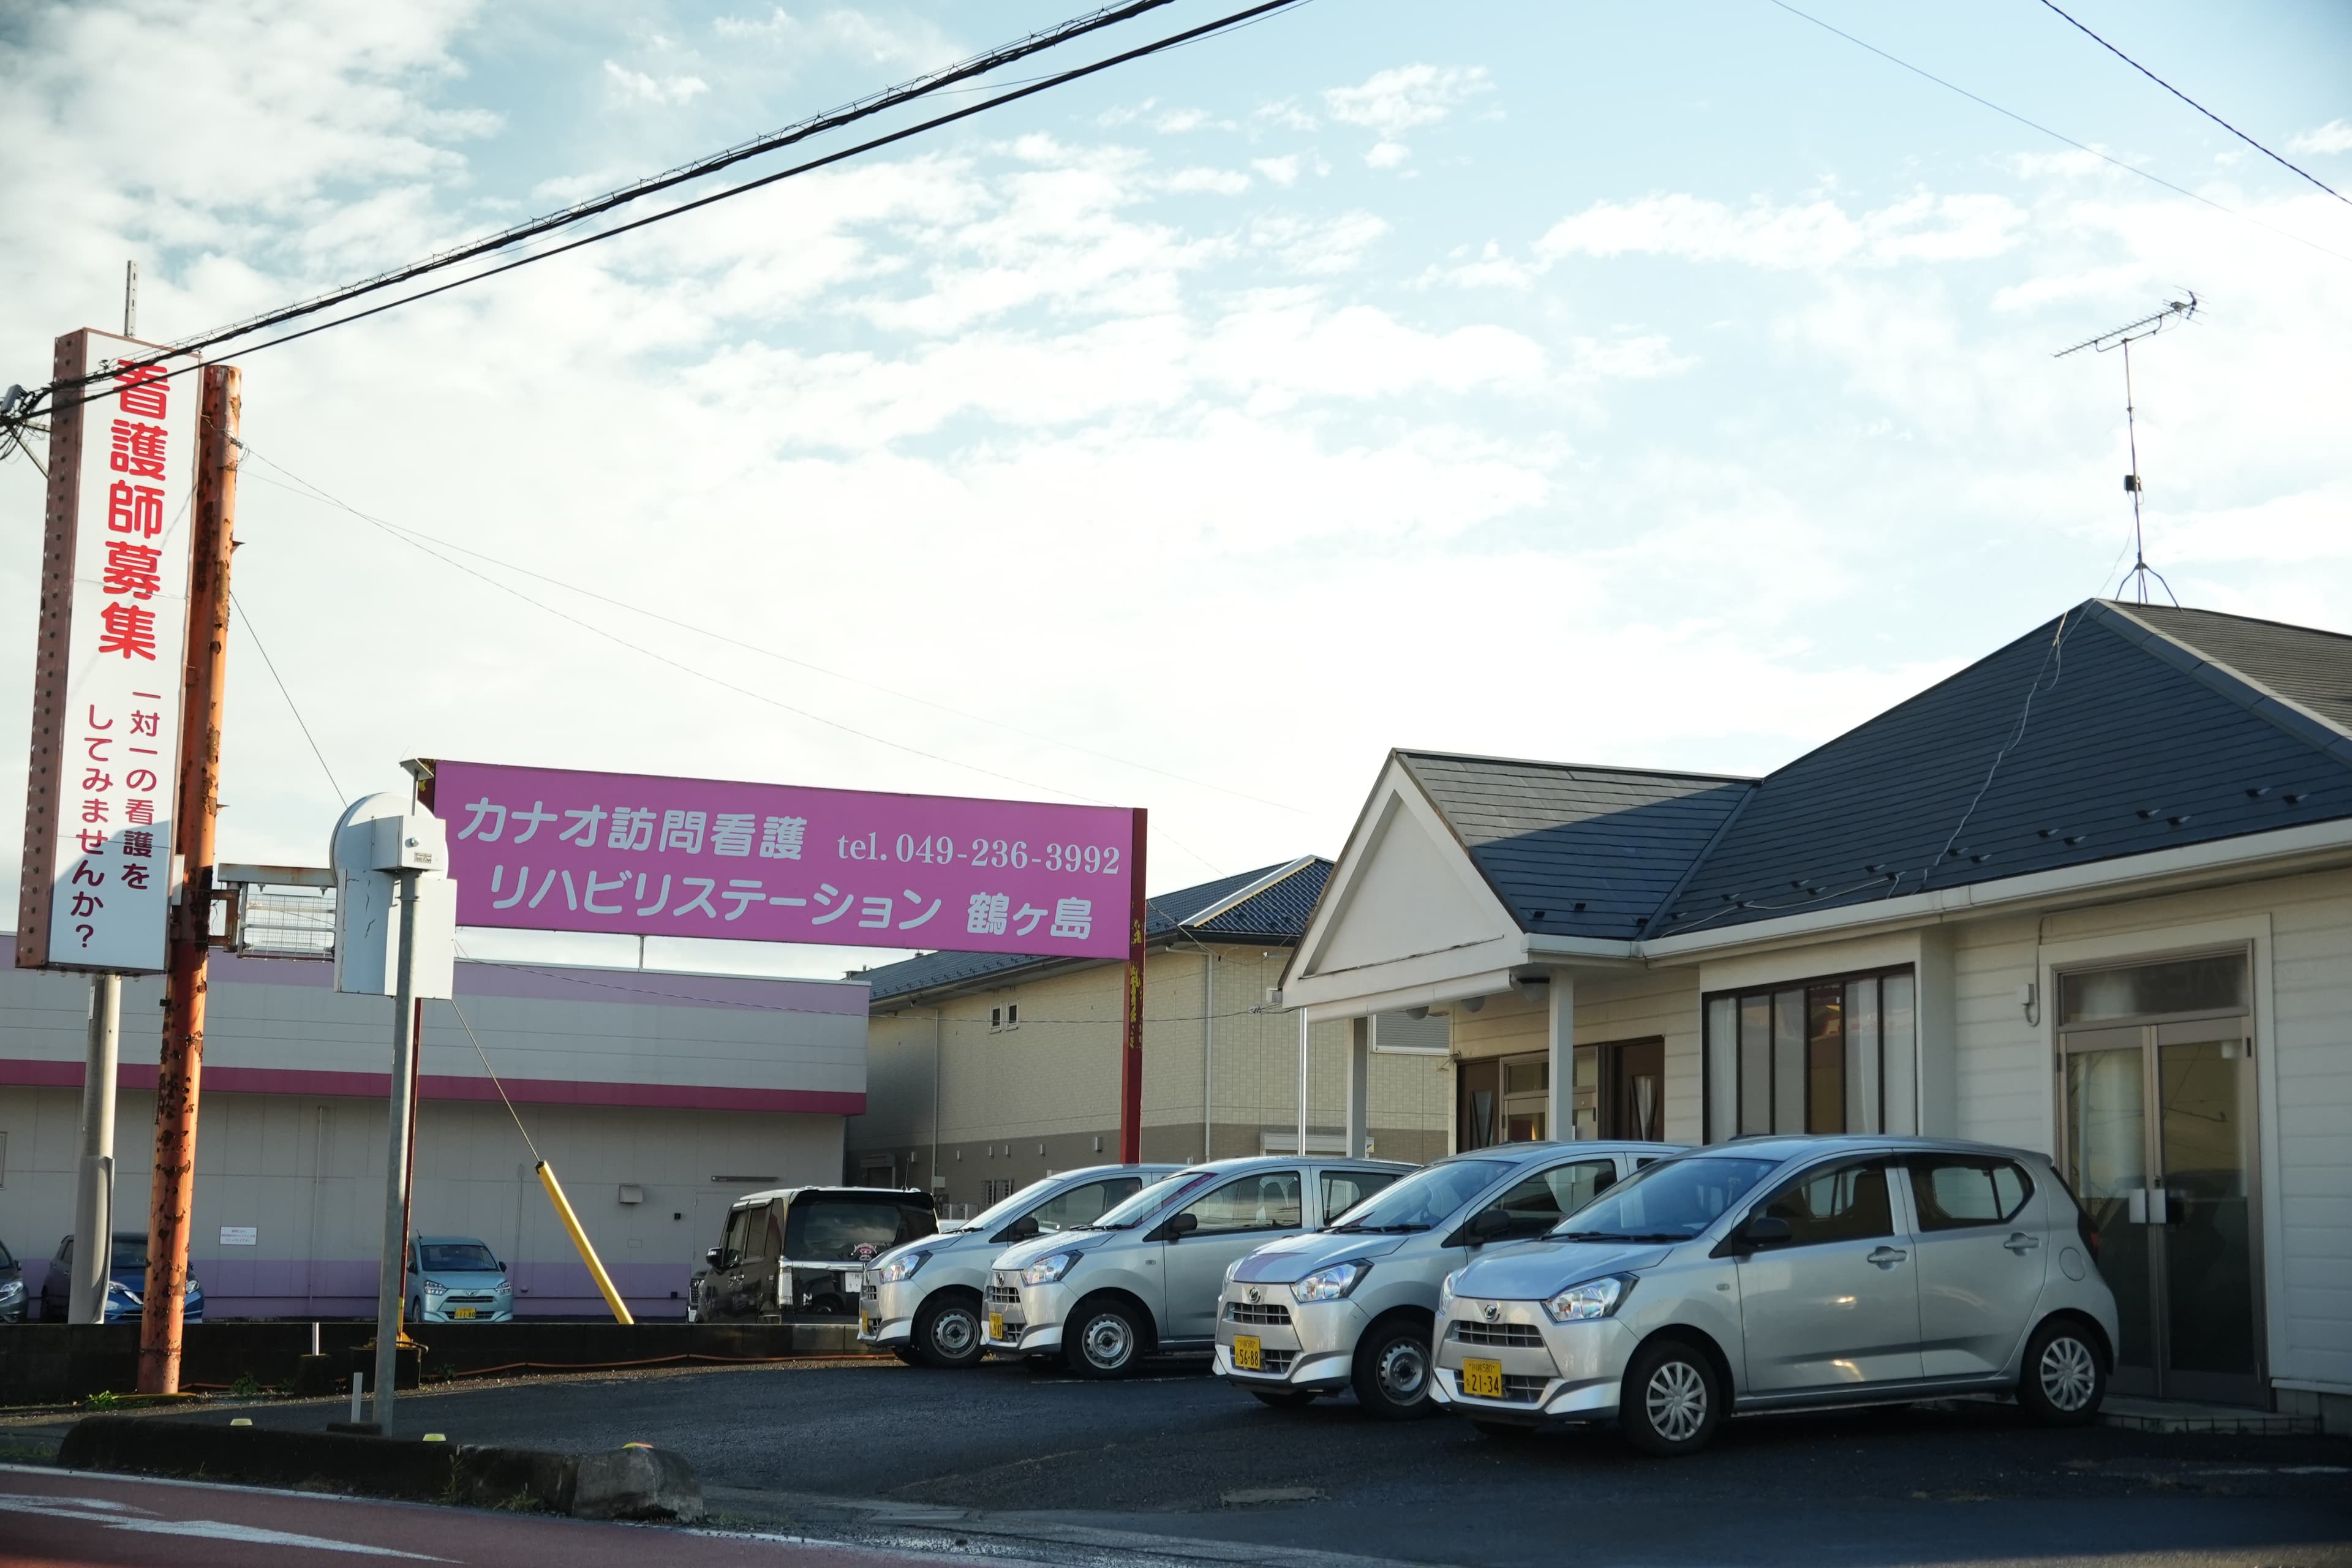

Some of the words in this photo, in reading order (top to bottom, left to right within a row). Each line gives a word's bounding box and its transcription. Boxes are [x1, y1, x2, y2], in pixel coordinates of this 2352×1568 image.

[99, 359, 171, 662] 看護師募集
[121, 692, 162, 891] 一対一の看護を
[458, 797, 808, 861] カナオ訪問看護
[895, 834, 1120, 875] 049-236-3992
[491, 865, 942, 930] リハビリステーション
[967, 891, 1093, 941] 鶴ヶ島
